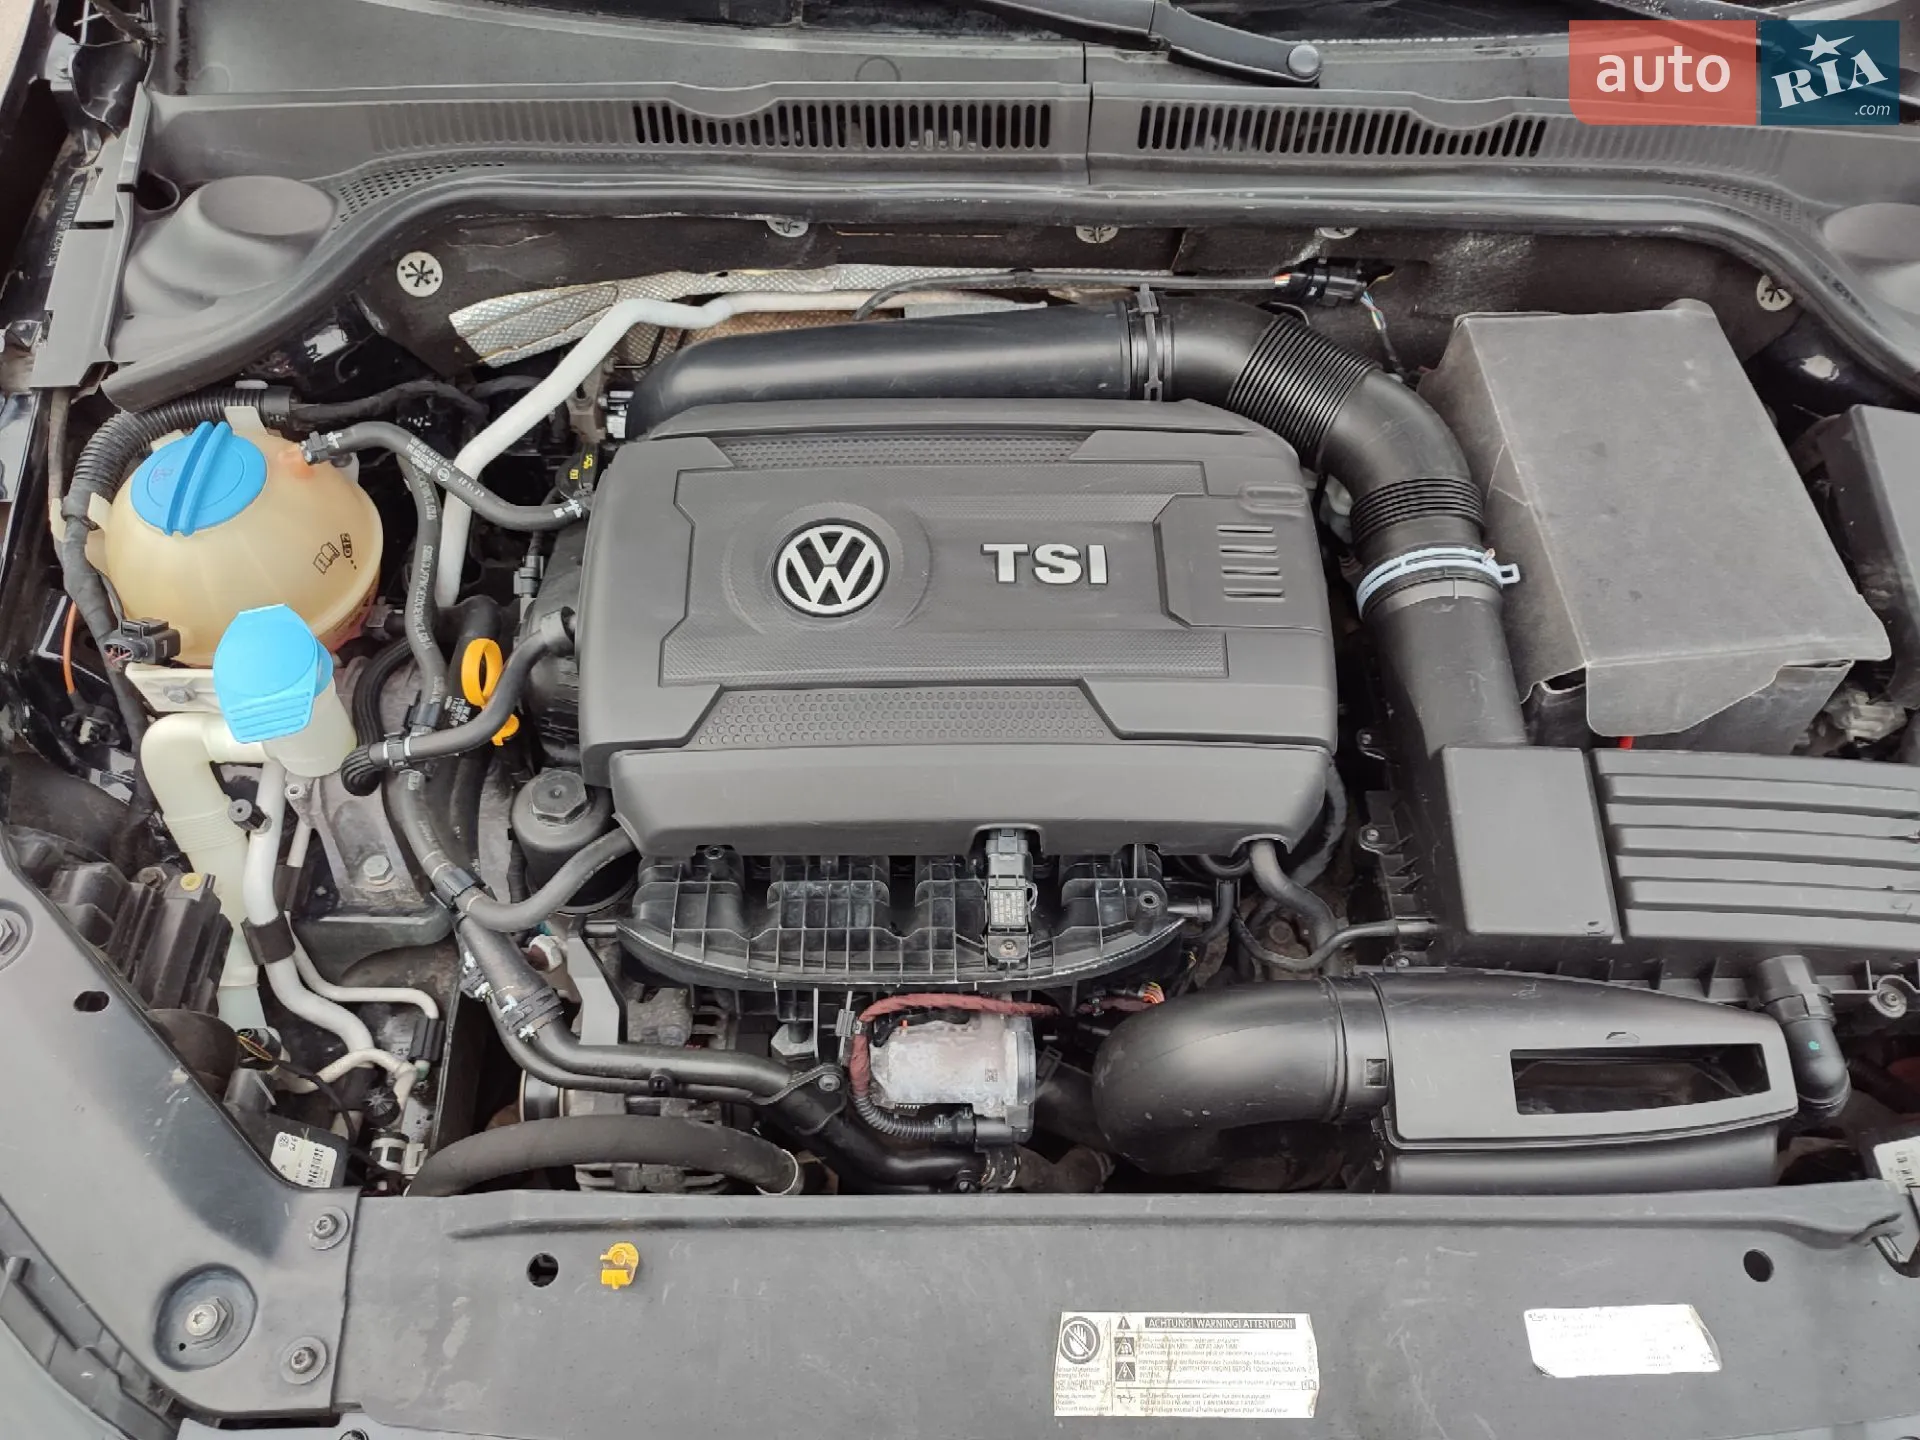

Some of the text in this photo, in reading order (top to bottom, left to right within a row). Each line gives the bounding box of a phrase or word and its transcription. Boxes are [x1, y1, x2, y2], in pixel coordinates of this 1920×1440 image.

[982, 543, 1109, 585] TSI
[1148, 1318, 1293, 1329] ACHTUNG! WARNING! ATTENTION!
